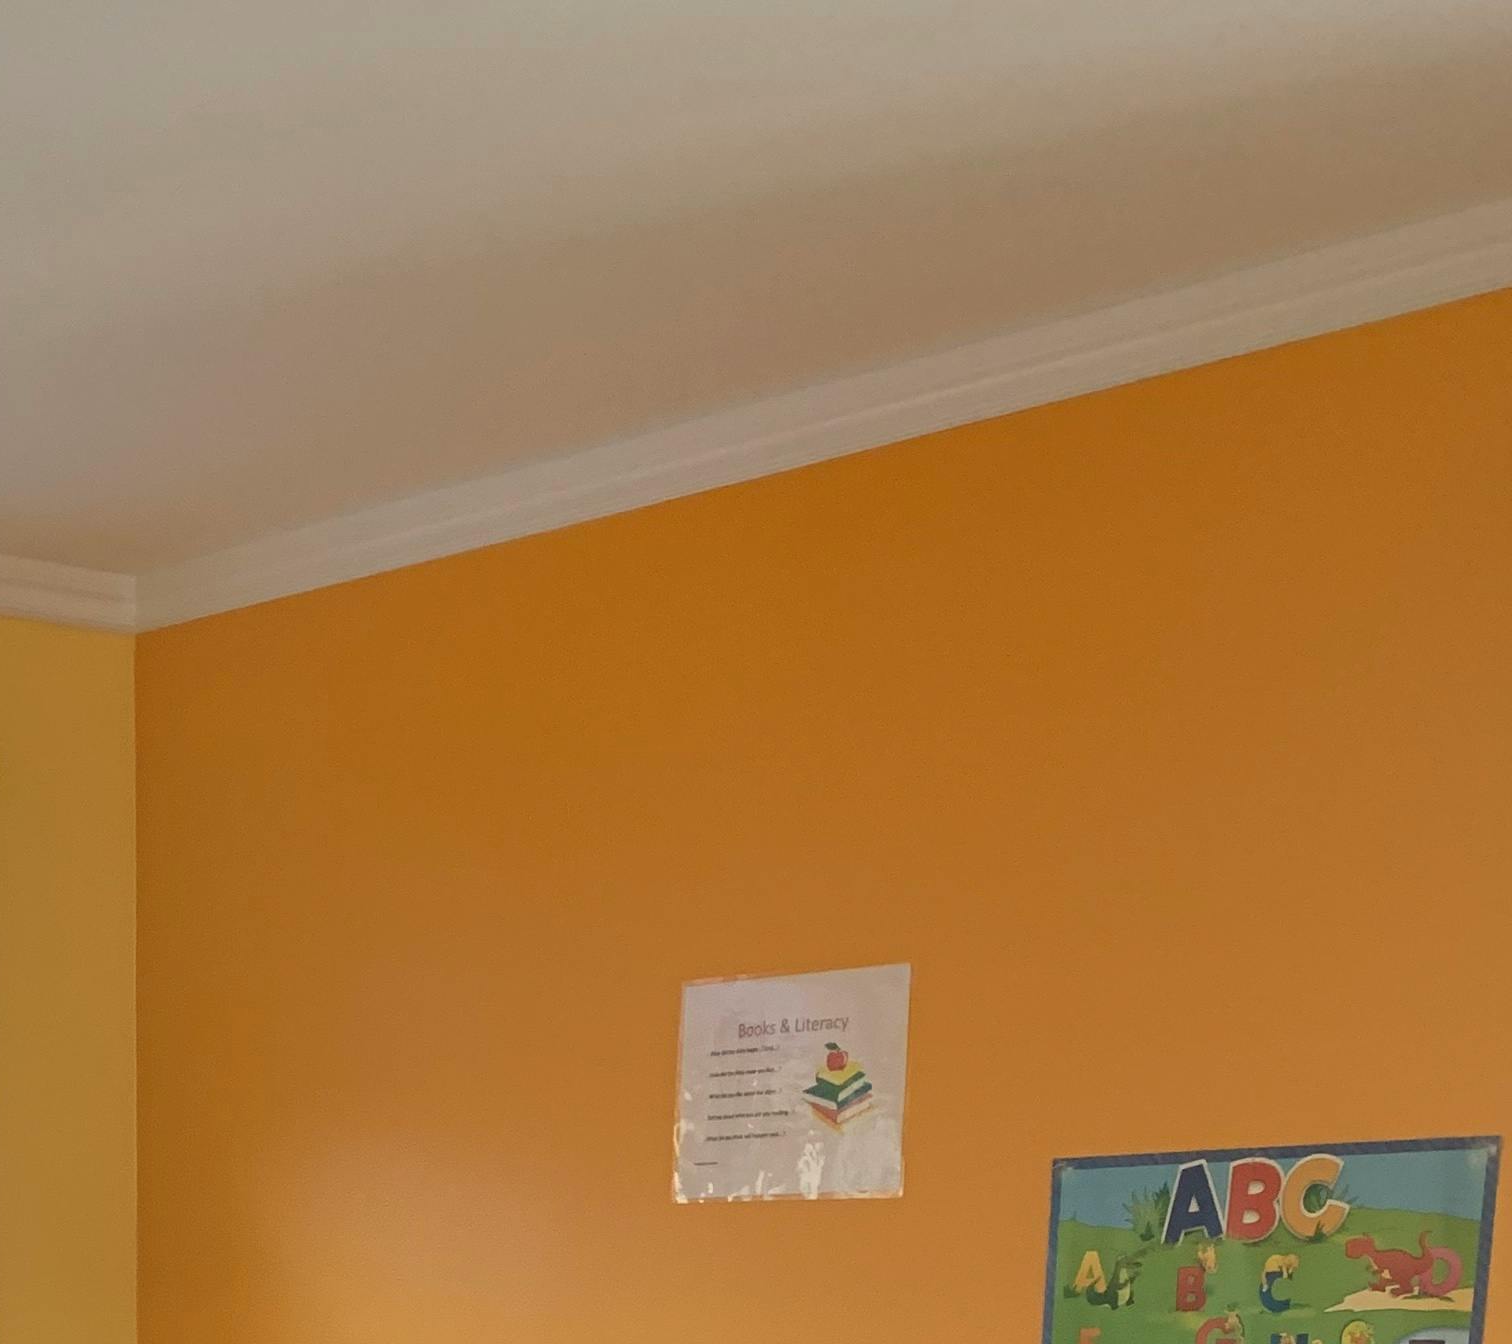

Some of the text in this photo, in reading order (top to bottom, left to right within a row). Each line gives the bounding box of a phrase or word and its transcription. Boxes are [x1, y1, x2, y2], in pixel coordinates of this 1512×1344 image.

[738, 1016, 850, 1039] Books & Literacy
[1161, 1154, 1351, 1246] ABC
[1073, 1251, 1108, 1295] A
[1176, 1266, 1207, 1313] B
[1259, 1268, 1292, 1313] C
